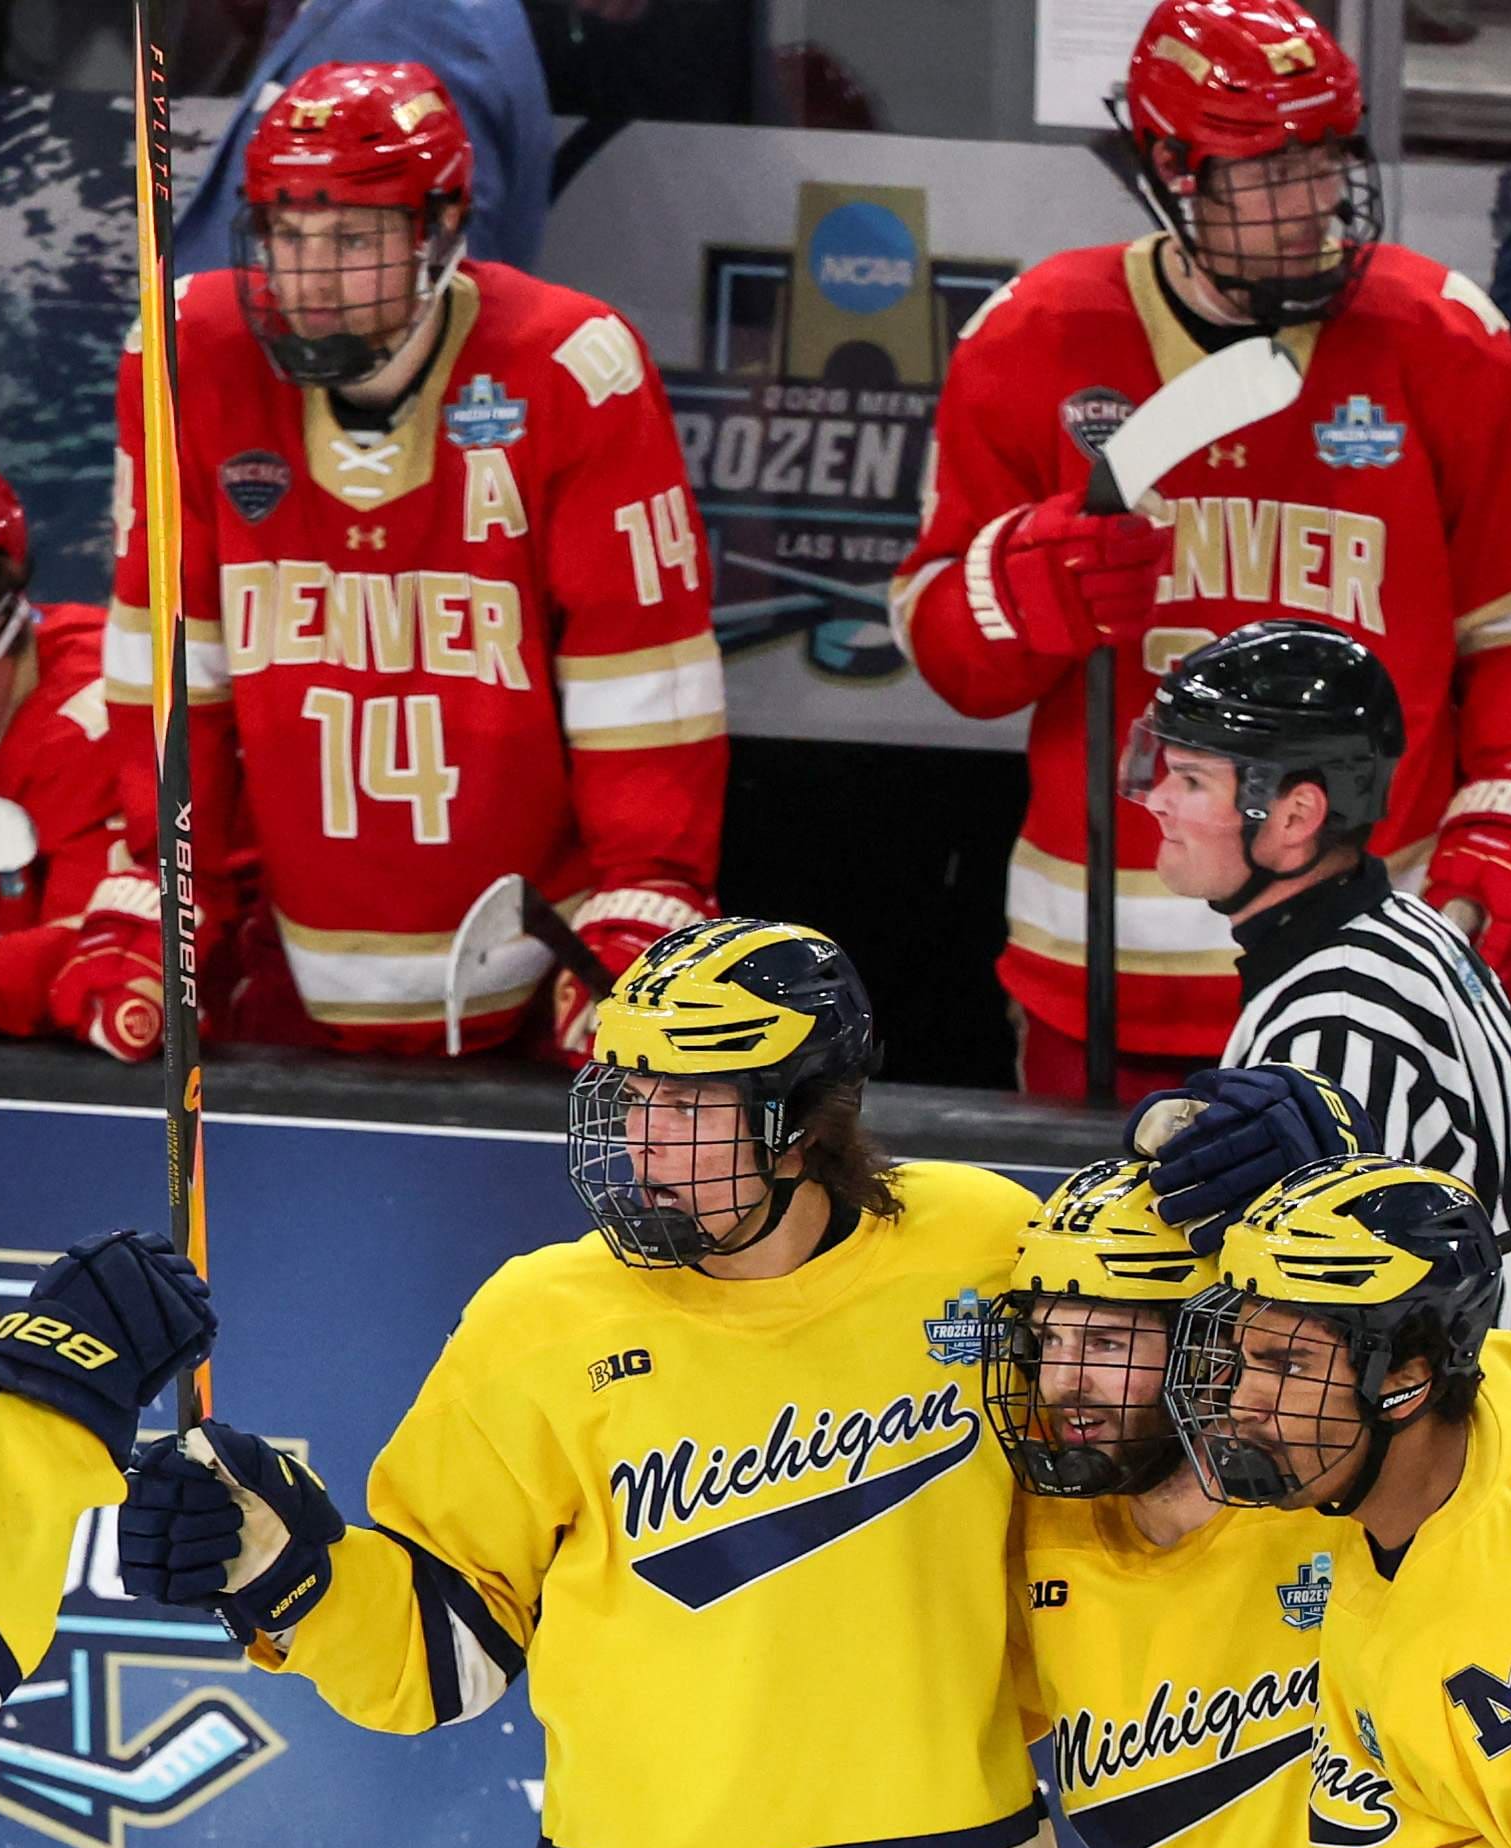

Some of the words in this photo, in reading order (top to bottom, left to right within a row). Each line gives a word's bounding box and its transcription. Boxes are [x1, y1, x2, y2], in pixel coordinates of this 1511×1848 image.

[151, 44, 169, 201] FLYLITE
[821, 256, 913, 287] NCAA
[856, 390, 928, 417] MEN
[462, 448, 528, 543] A
[676, 408, 906, 500] ROZEN
[615, 486, 696, 606] 14
[842, 537, 916, 563] VEGA
[220, 559, 531, 692] DENVER
[302, 685, 460, 846] 14
[175, 838, 197, 1008] BAUER
[1050, 1202, 1104, 1233] 18
[932, 1324, 974, 1338] FROZEN
[612, 1381, 963, 1539] Michigan
[270, 1573, 317, 1619] BAUER
[1050, 1658, 1321, 1795] Michigan
